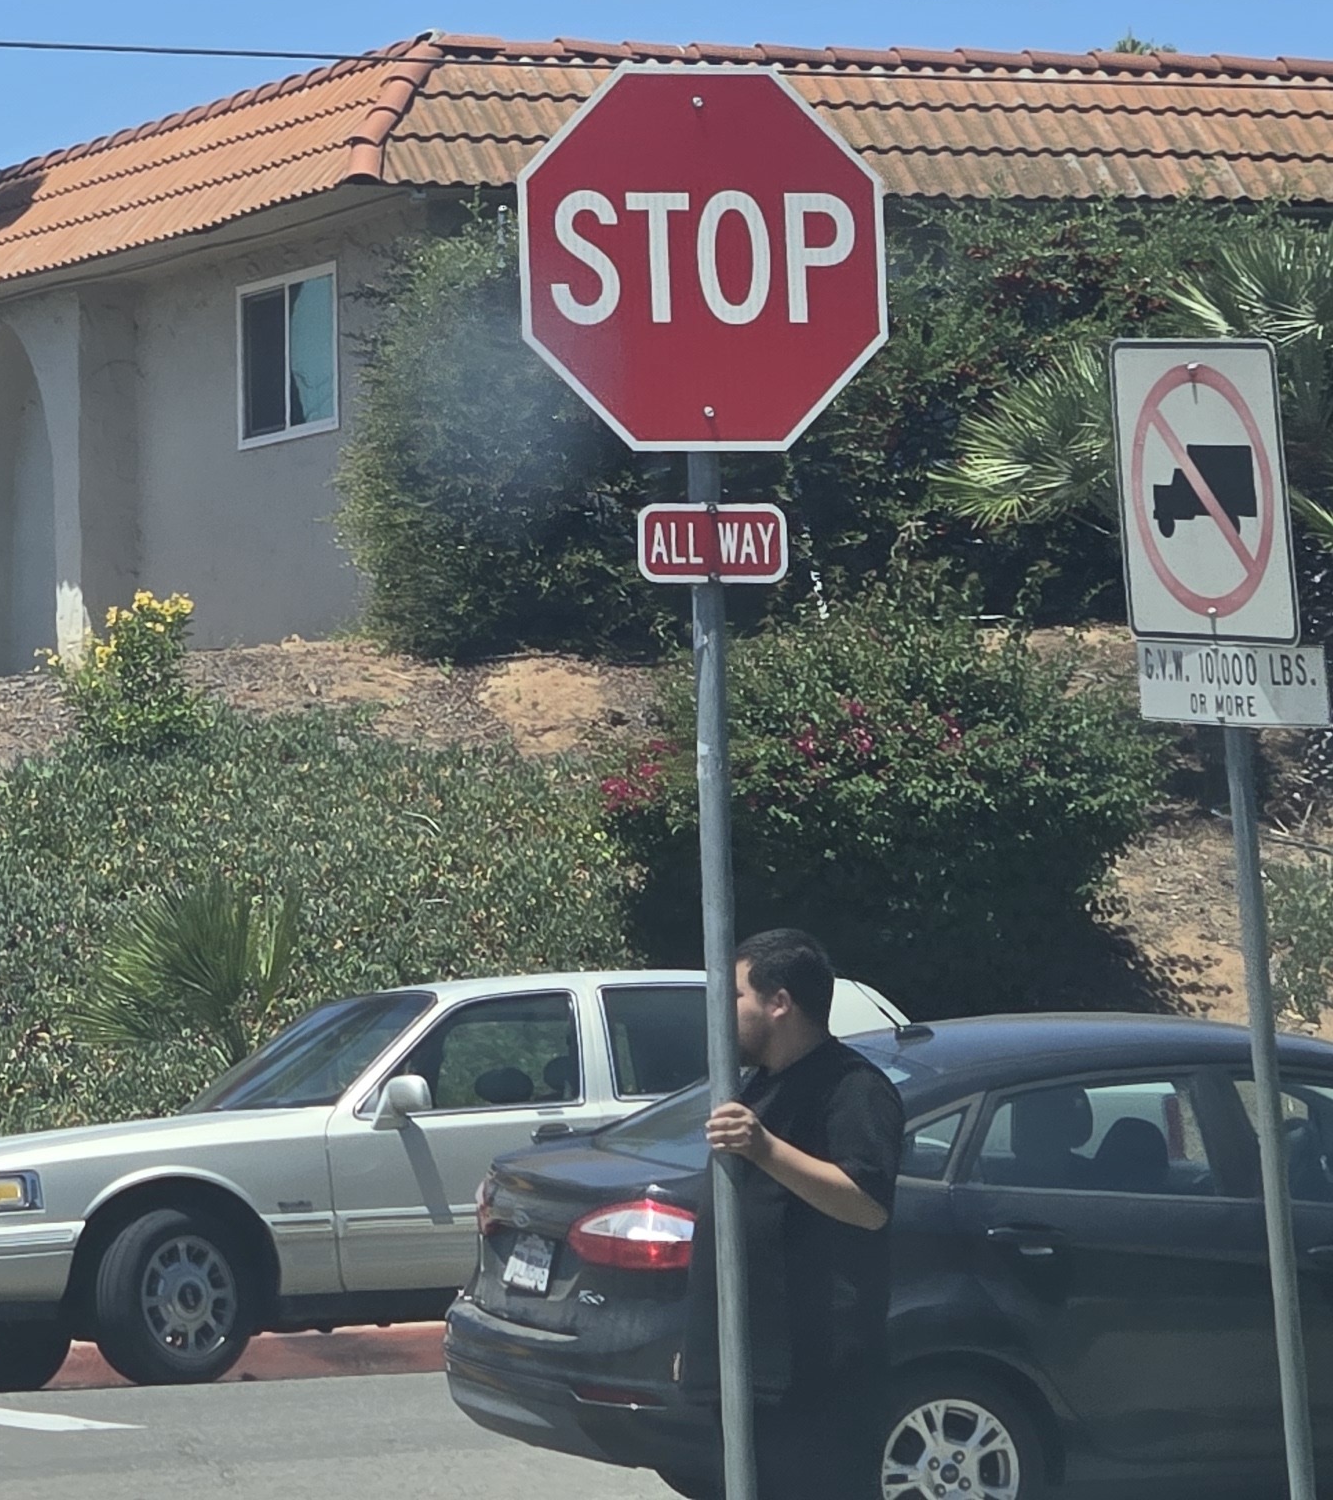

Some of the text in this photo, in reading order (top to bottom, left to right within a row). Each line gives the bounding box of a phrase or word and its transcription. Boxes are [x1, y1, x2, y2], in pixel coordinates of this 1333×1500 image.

[551, 190, 855, 325] STOP
[651, 522, 775, 564] ALL WAY
[1144, 647, 1317, 690] G.V.W. 10,000 LBS.
[1190, 693, 1258, 717] OR MORE
